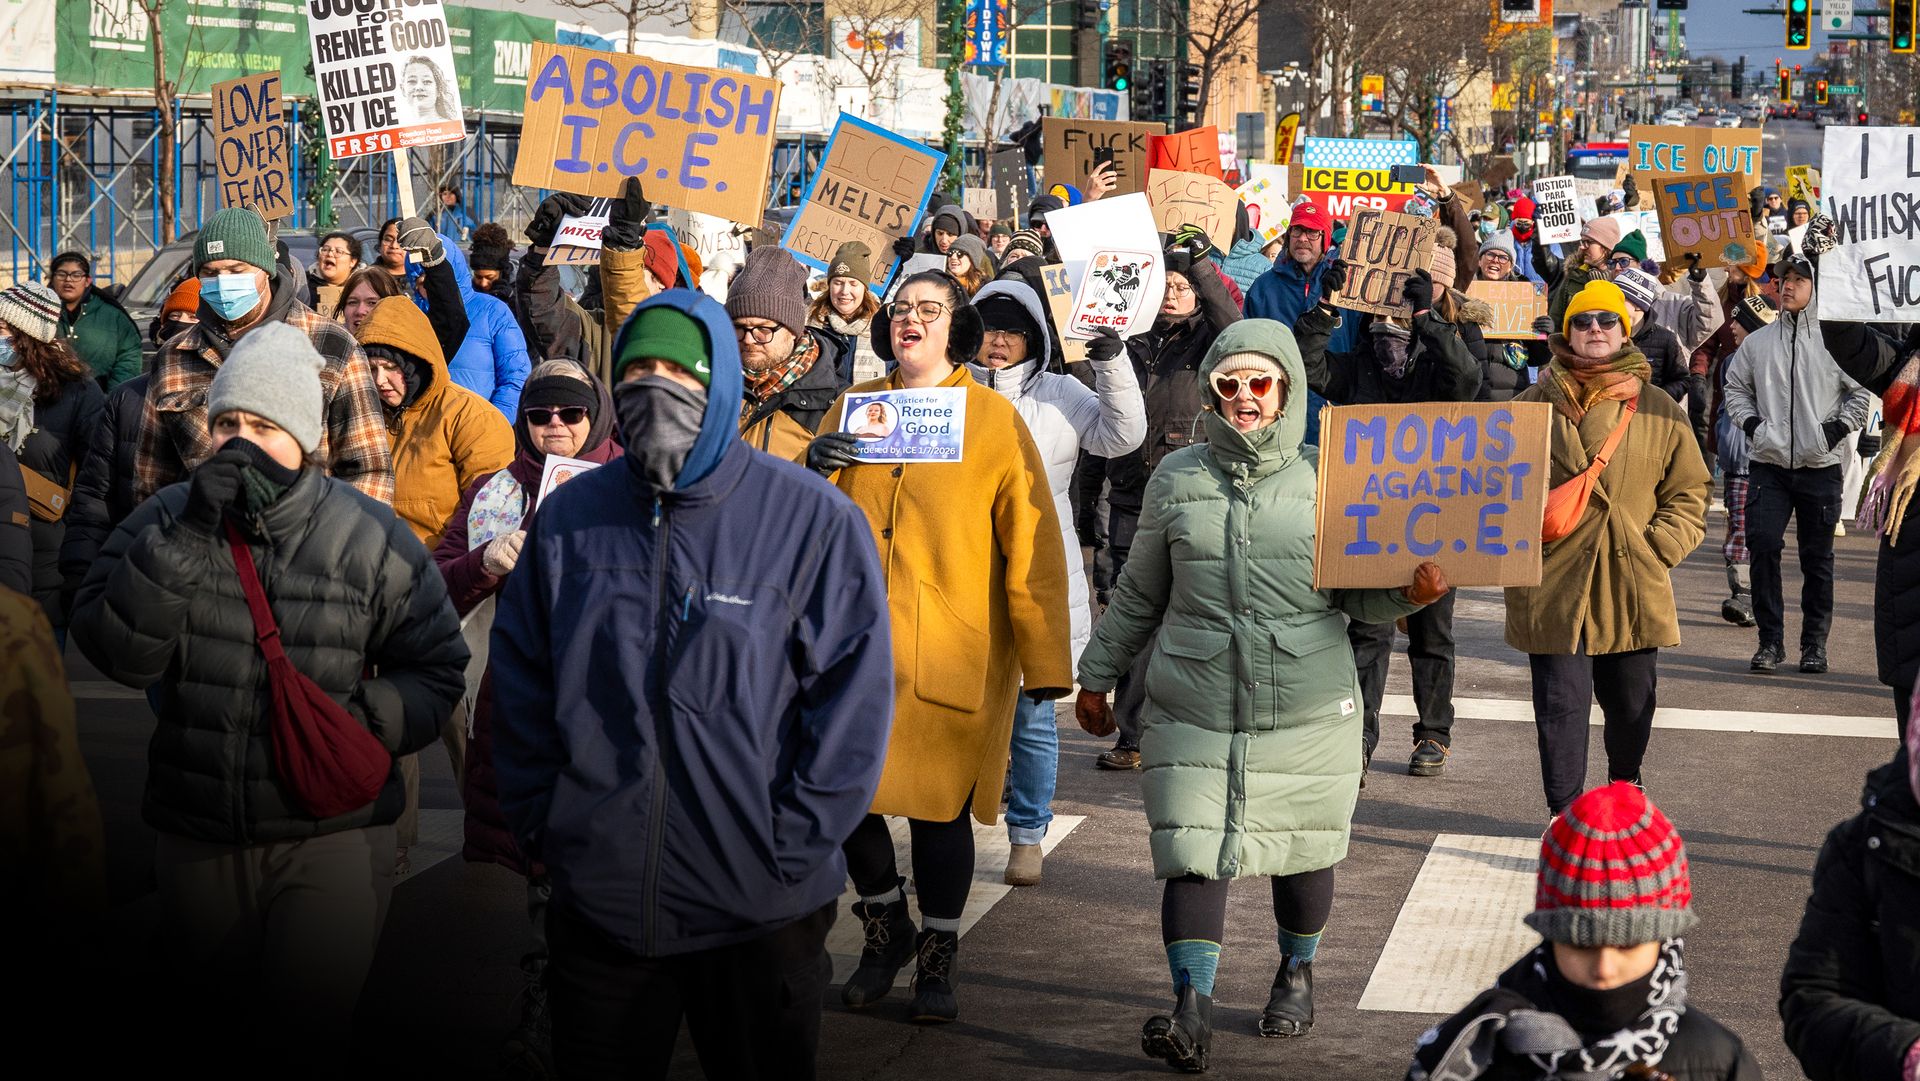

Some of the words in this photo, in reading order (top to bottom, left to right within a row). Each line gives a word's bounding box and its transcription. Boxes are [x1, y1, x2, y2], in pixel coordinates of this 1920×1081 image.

[356, 9, 404, 27] FOR
[315, 25, 386, 64] RENEE
[390, 18, 446, 52] GOOD
[321, 62, 397, 102] KILLED
[530, 54, 775, 136] ABOLISH
[219, 77, 281, 132] LOVE
[326, 102, 356, 135] BY
[361, 96, 399, 130] ICE
[220, 125, 284, 177] OVER
[335, 133, 392, 157] FRSO
[554, 115, 728, 193] I.C.E.
[1063, 129, 1147, 153] FUCK
[1635, 141, 1686, 173] ICE
[1703, 144, 1760, 175] OUT
[1860, 132, 1870, 179] I
[1083, 160, 1127, 177] IE
[1305, 169, 1349, 191] ICE
[1354, 170, 1408, 193] OU
[1535, 179, 1573, 193] JUSTICIA
[223, 170, 288, 212] FEAR
[817, 177, 911, 231] MELTS
[1158, 175, 1224, 206] ICE
[1541, 199, 1575, 215] RENEE
[1545, 190, 1566, 201] PARA
[1664, 177, 1738, 215] ICE
[825, 214, 878, 242] UNDER
[1543, 212, 1576, 228] GOOD
[1670, 210, 1752, 247] OUT!
[792, 226, 894, 284] RESICE
[1347, 210, 1430, 270] FUCK
[1339, 262, 1412, 306] ICE
[1080, 314, 1109, 325] FUCK
[894, 397, 924, 405] Justice
[925, 396, 938, 404] for
[901, 405, 953, 418] Renee
[905, 421, 950, 435] Good
[1343, 409, 1516, 465] MOMS
[889, 446, 901, 456] by
[902, 446, 917, 454] ICE
[918, 446, 956, 455] 1/7/2026
[1362, 462, 1532, 502] AGAINST
[1343, 502, 1530, 557] I.C.E.
